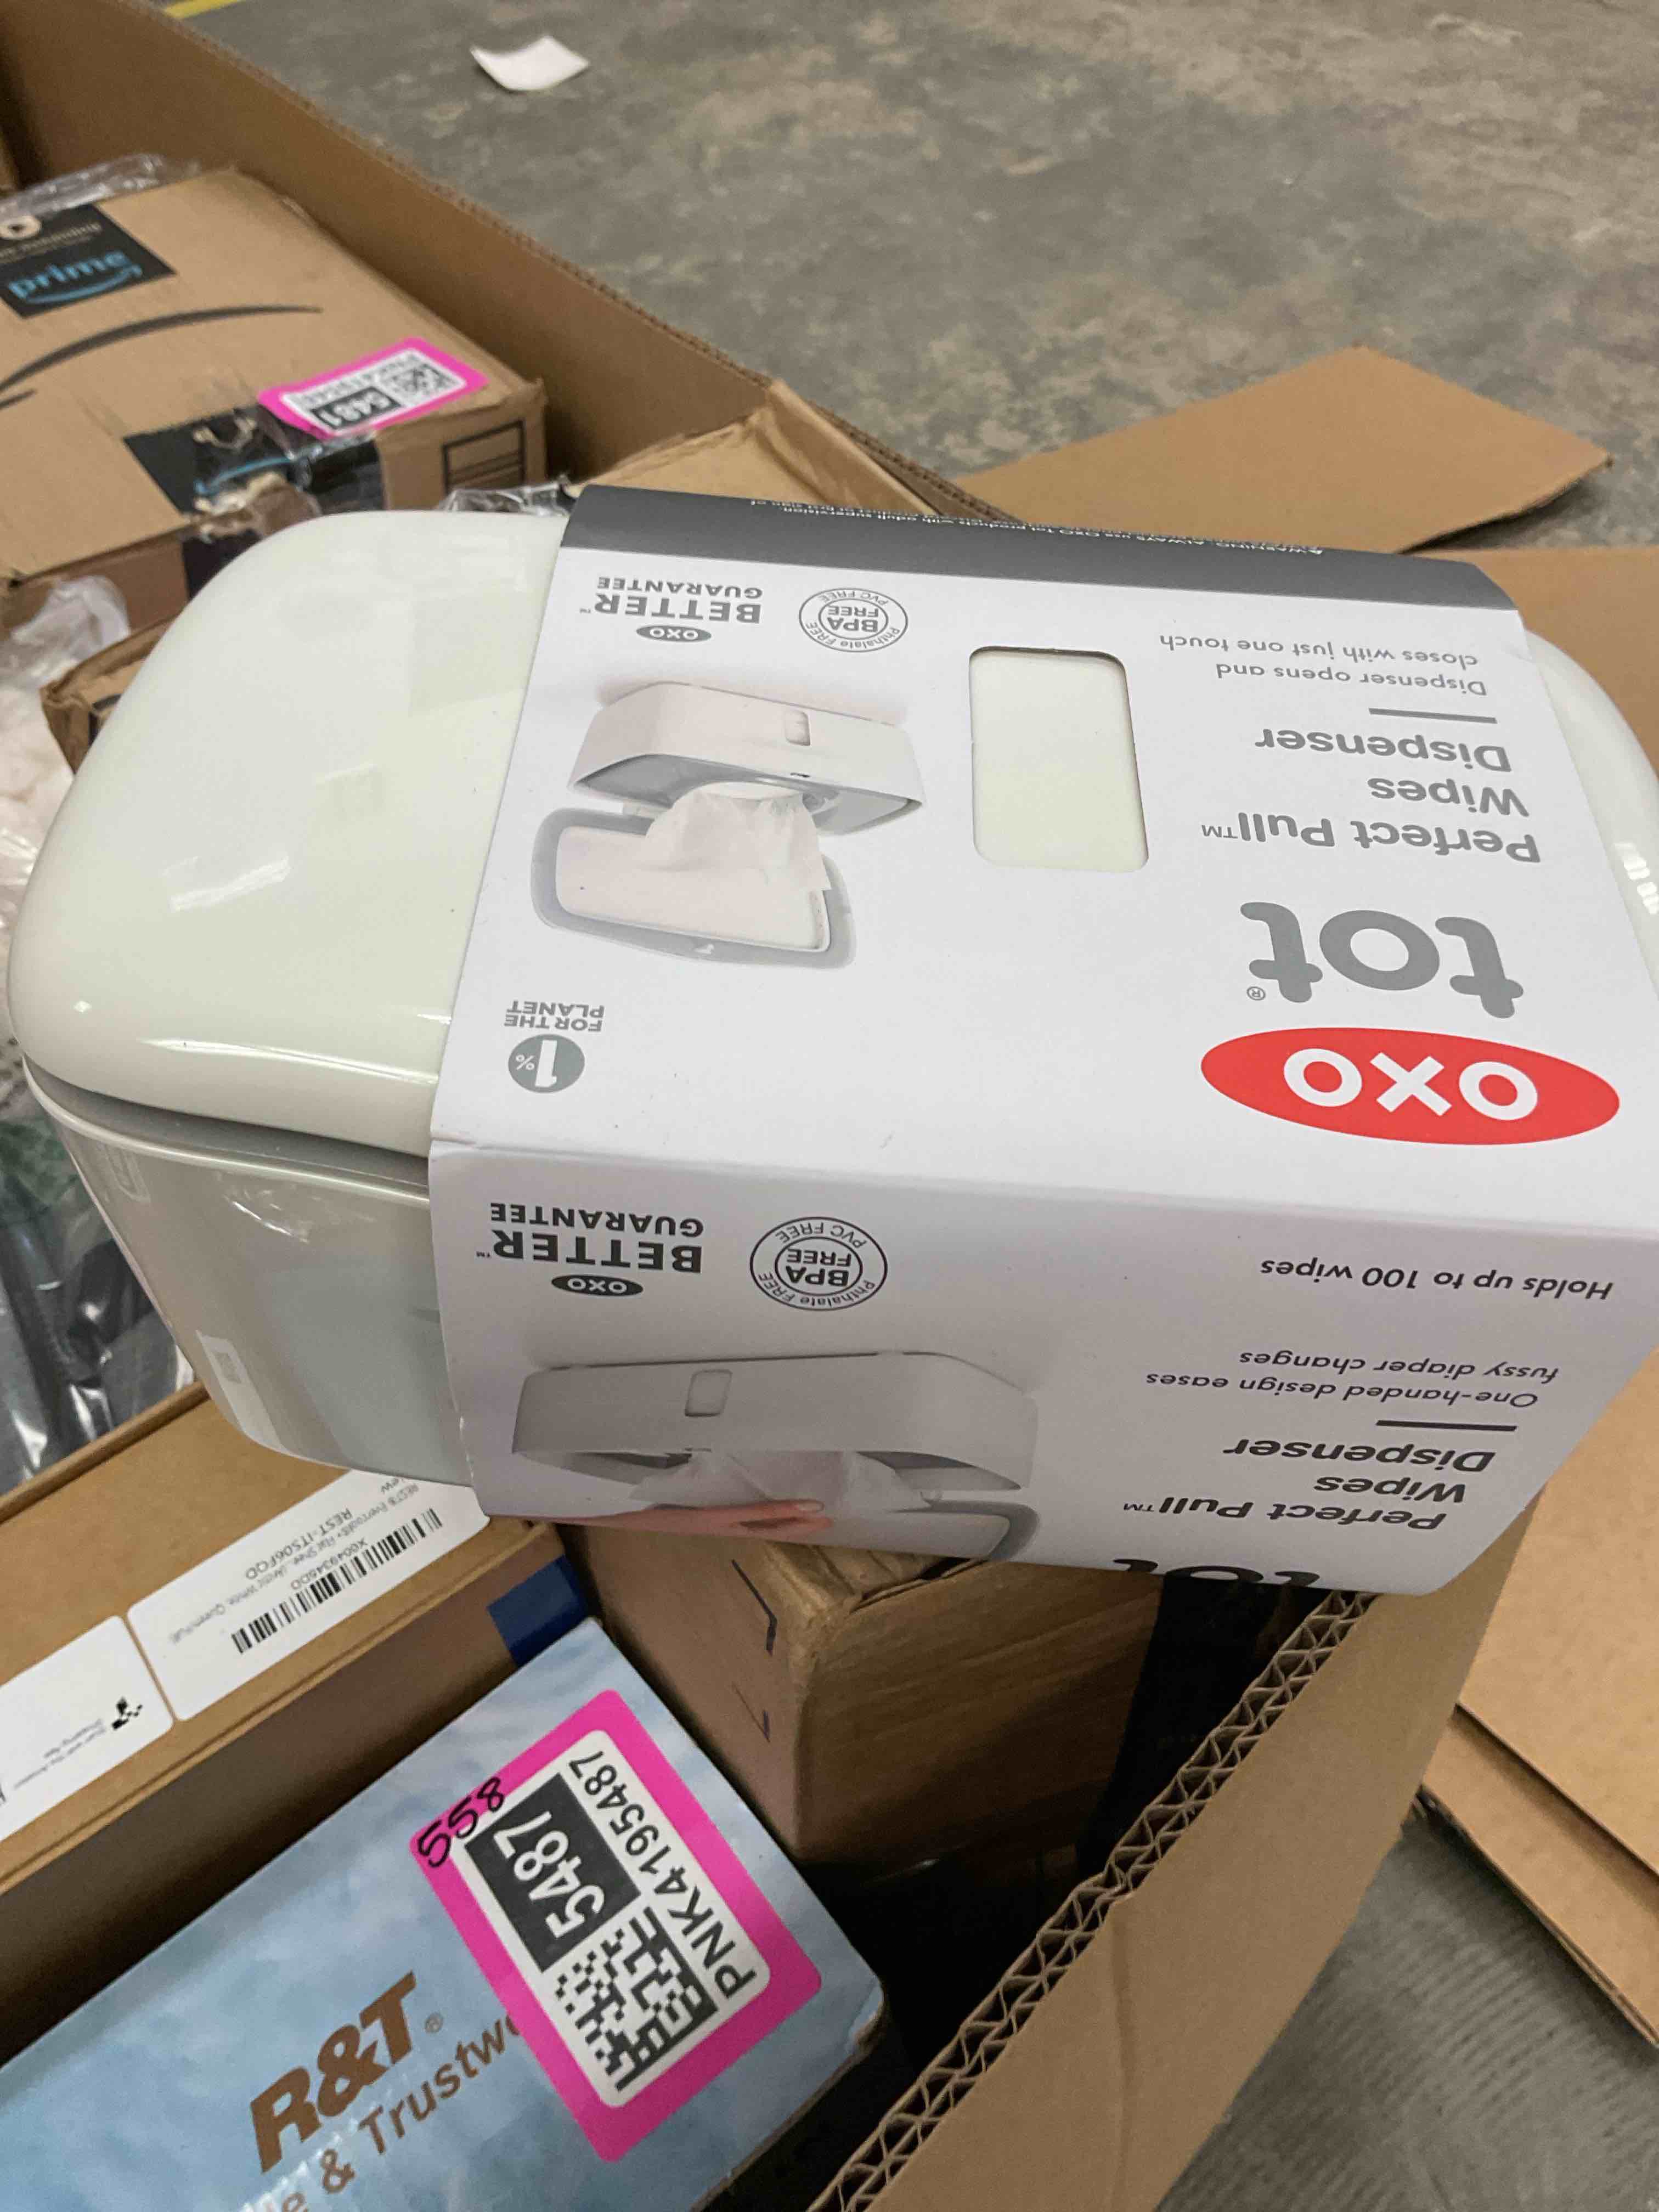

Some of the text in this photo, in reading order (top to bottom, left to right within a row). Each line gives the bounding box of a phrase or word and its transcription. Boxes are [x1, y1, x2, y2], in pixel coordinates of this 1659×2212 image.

[8, 250, 131, 300] prime
[597, 576, 763, 599] GUARANTEE
[817, 589, 890, 607] PVC FREE
[827, 604, 879, 618] FREE
[827, 616, 878, 633] BPA
[648, 628, 698, 640] OXO
[805, 621, 900, 650] Phthalate FREE
[1159, 634, 1478, 670] closes with just one touch
[1216, 662, 1487, 696] Dispenser opens and
[1254, 728, 1512, 772] Dispenser
[1367, 777, 1529, 817] Wipes
[1349, 820, 1541, 864] Perfect
[504, 1014, 602, 1032] FOR THE
[506, 1000, 605, 1019] PLANET
[515, 1039, 558, 1088] 1%
[1283, 1048, 1538, 1121] OXO
[490, 1202, 704, 1238] GUARANTEE
[775, 1221, 866, 1250] PVC FREE
[786, 1248, 853, 1267] FREE
[566, 1277, 628, 1293] OXO
[758, 1271, 874, 1308] Phthalate FREE
[785, 1265, 850, 1286] BPA
[1259, 1257, 1613, 1300] Holds up to 100 wipes
[1239, 1350, 1559, 1384] fussy diaper changes
[1146, 1373, 1538, 1408] One-handed design eases
[1222, 1439, 1496, 1471] Dispenser
[1313, 1477, 1468, 1503] Wipes
[1267, 1503, 1447, 1530] Perfect
[415, 1776, 506, 1870] 558
[492, 1810, 606, 1939] 5487
[568, 1750, 757, 1999] PNK4195487
[320, 2148, 356, 2193] &
